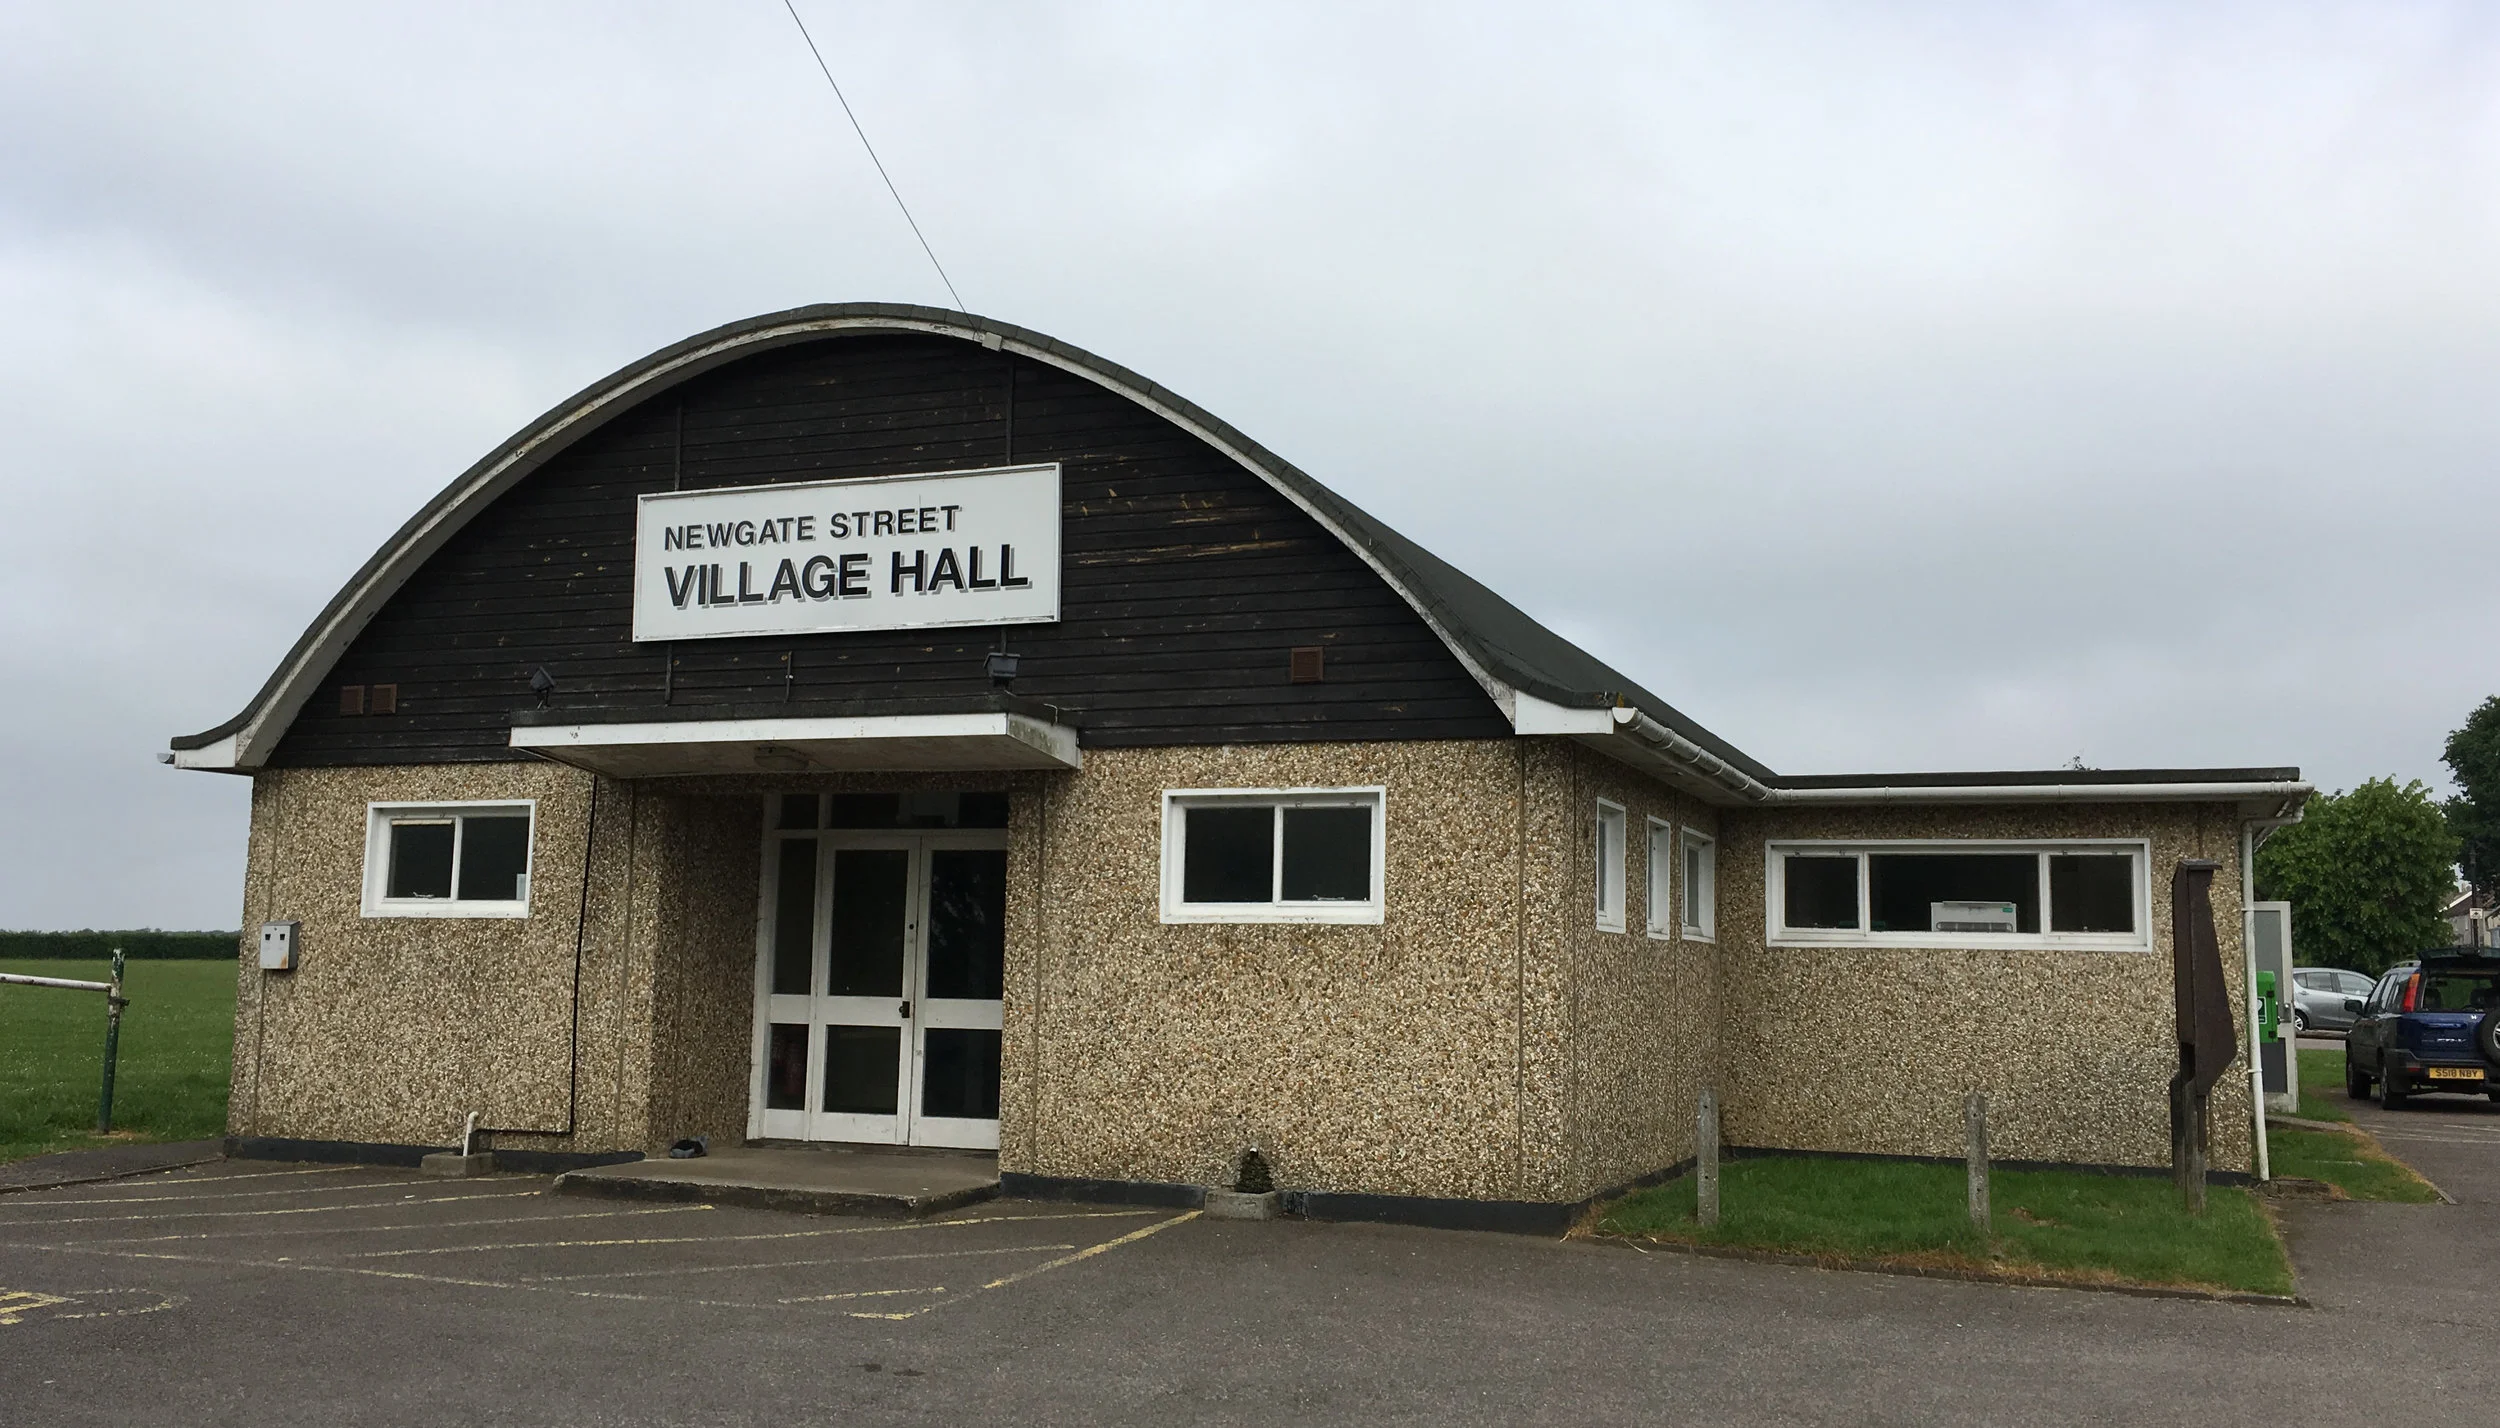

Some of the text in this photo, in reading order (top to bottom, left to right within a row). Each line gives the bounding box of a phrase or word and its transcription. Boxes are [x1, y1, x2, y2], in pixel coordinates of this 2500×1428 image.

[664, 504, 962, 550] NEWGATE STREET
[664, 543, 1032, 609] VILLAGE HALL
[2460, 1069, 2478, 1078] NBY
